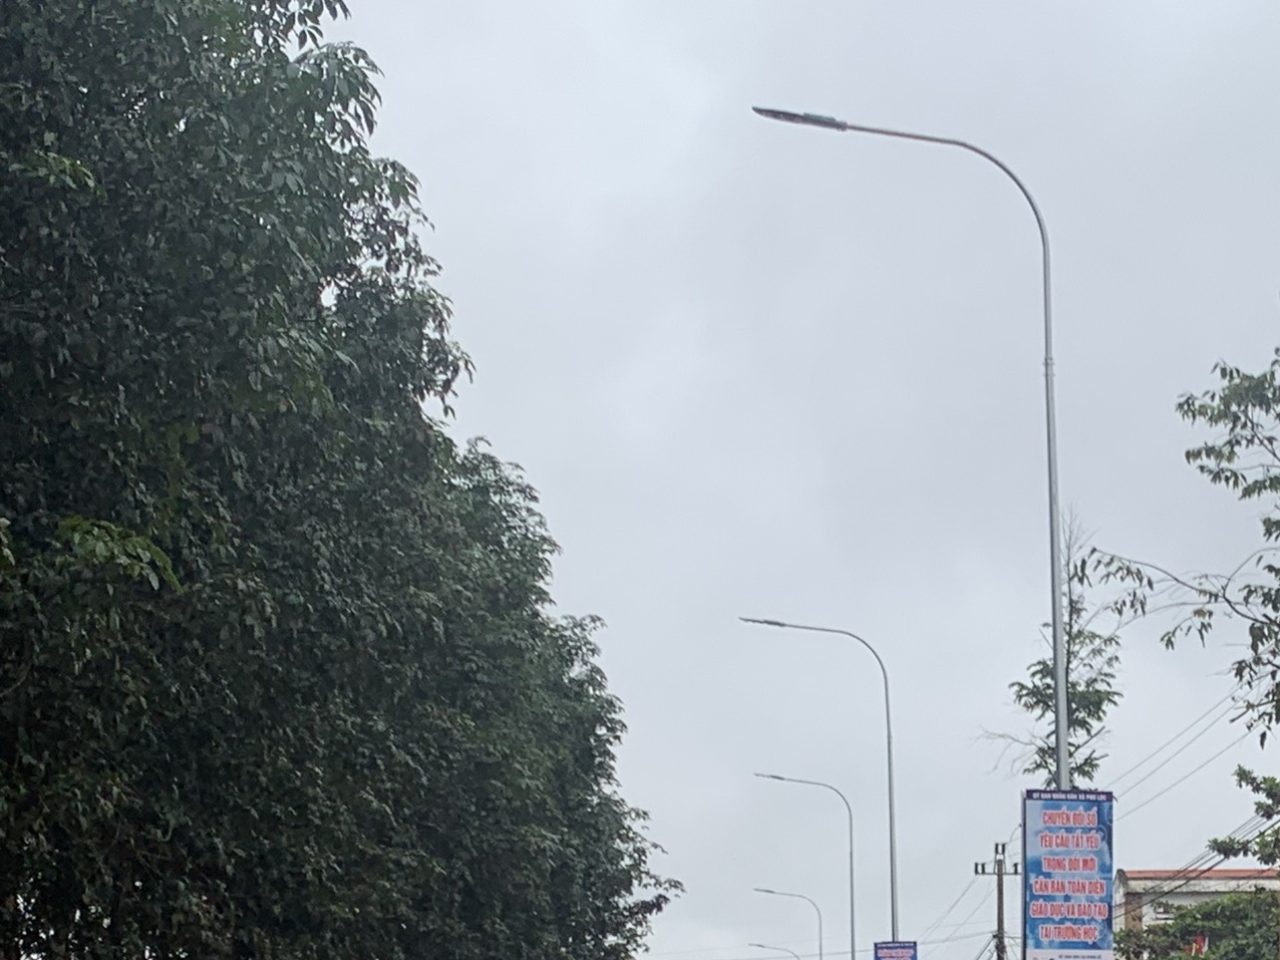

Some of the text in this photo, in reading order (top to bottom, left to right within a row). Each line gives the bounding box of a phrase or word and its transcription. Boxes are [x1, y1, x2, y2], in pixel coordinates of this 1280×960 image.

[1043, 805, 1097, 826] CHUYỂN ĐỔI SỐ
[1041, 828, 1099, 849] YÊU CẦU TẤT YẾU
[1043, 853, 1096, 872] TRONG ĐỔI MỚI
[1034, 876, 1049, 893] CĂN
[1067, 878, 1086, 894] TOÀN
[1088, 878, 1105, 895] DIỆN
[1031, 899, 1048, 917] GIÁO
[1049, 903, 1064, 920] DỤC
[1066, 901, 1076, 917] VÀ
[1093, 903, 1107, 921] TẠO
[1040, 922, 1098, 944] TẠI TRƯỜNG HỌC
